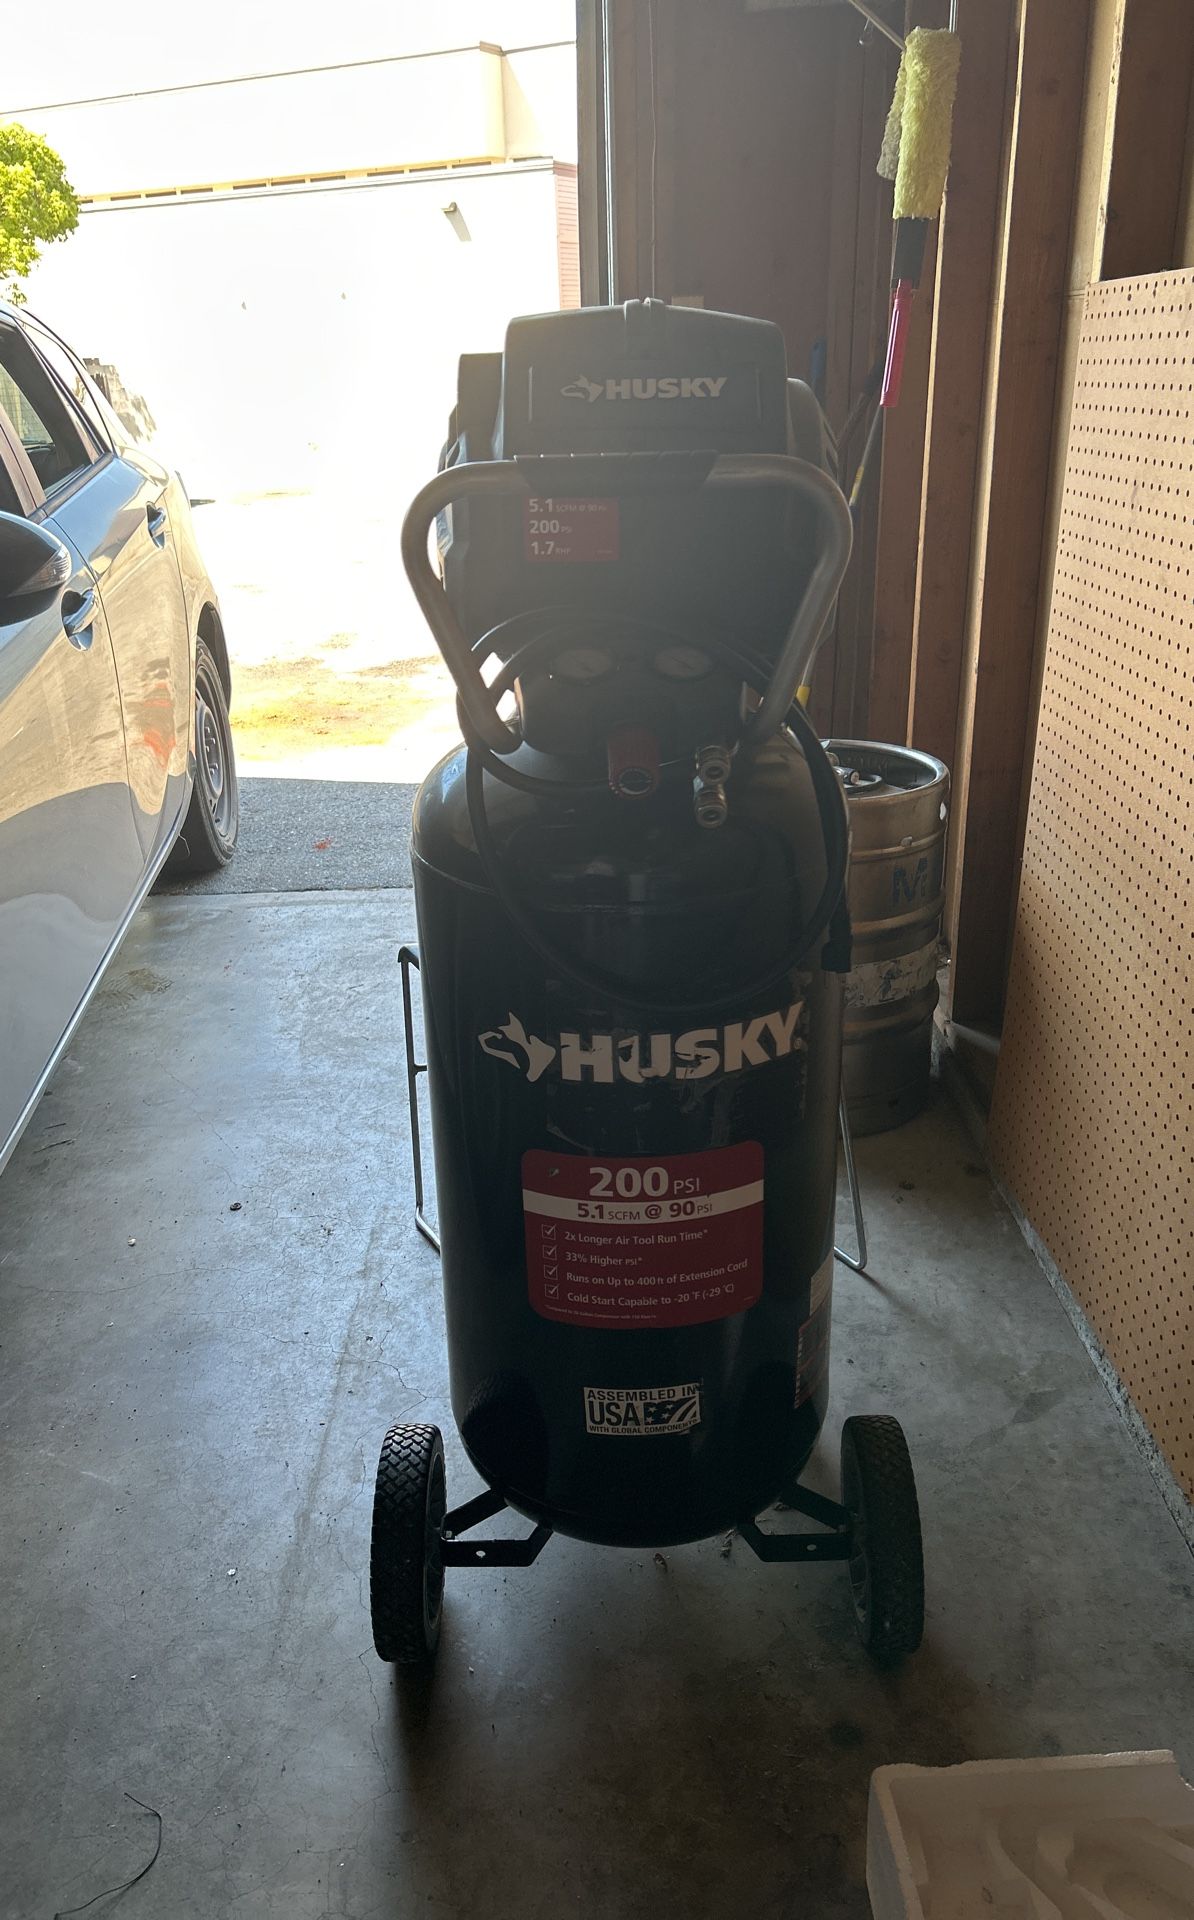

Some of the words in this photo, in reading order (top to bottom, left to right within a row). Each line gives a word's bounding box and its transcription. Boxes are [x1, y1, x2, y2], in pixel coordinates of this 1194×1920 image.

[606, 377, 728, 400] HUSKY
[528, 498, 553, 513] 5.1
[529, 520, 560, 534] 200
[531, 541, 554, 556] 1.7
[559, 1001, 805, 1083] HUSKY
[589, 1166, 669, 1198] 200
[673, 1178, 701, 1195] PSI
[577, 1202, 604, 1220] 5.1
[607, 1210, 641, 1221] SCFM
[644, 1204, 662, 1220] @
[669, 1200, 695, 1217] 90
[696, 1202, 713, 1215] PSI
[564, 1231, 577, 1241] 2x
[578, 1234, 614, 1246] Longer
[615, 1235, 630, 1245] Air
[633, 1234, 655, 1245] Tool
[657, 1233, 677, 1244] Run
[565, 1251, 588, 1263] 33%
[590, 1254, 623, 1268] Higher
[567, 1272, 590, 1284] Runs
[591, 1276, 605, 1286] on
[607, 1276, 622, 1288] Up
[624, 1277, 635, 1286] to
[637, 1276, 656, 1286] 400
[666, 1274, 678, 1285] of
[679, 1266, 726, 1283] Extension
[727, 1258, 749, 1273] Cord
[567, 1292, 590, 1304] Cold
[591, 1294, 616, 1306] Start
[617, 1295, 659, 1308] Capable
[660, 1295, 672, 1305] to
[673, 1293, 690, 1304] -20
[587, 1388, 676, 1402] ASSEMBLED
[682, 1384, 697, 1397] IN
[588, 1401, 641, 1426] USA
[589, 1425, 610, 1433] WITH
[611, 1426, 642, 1434] GLOBAL
